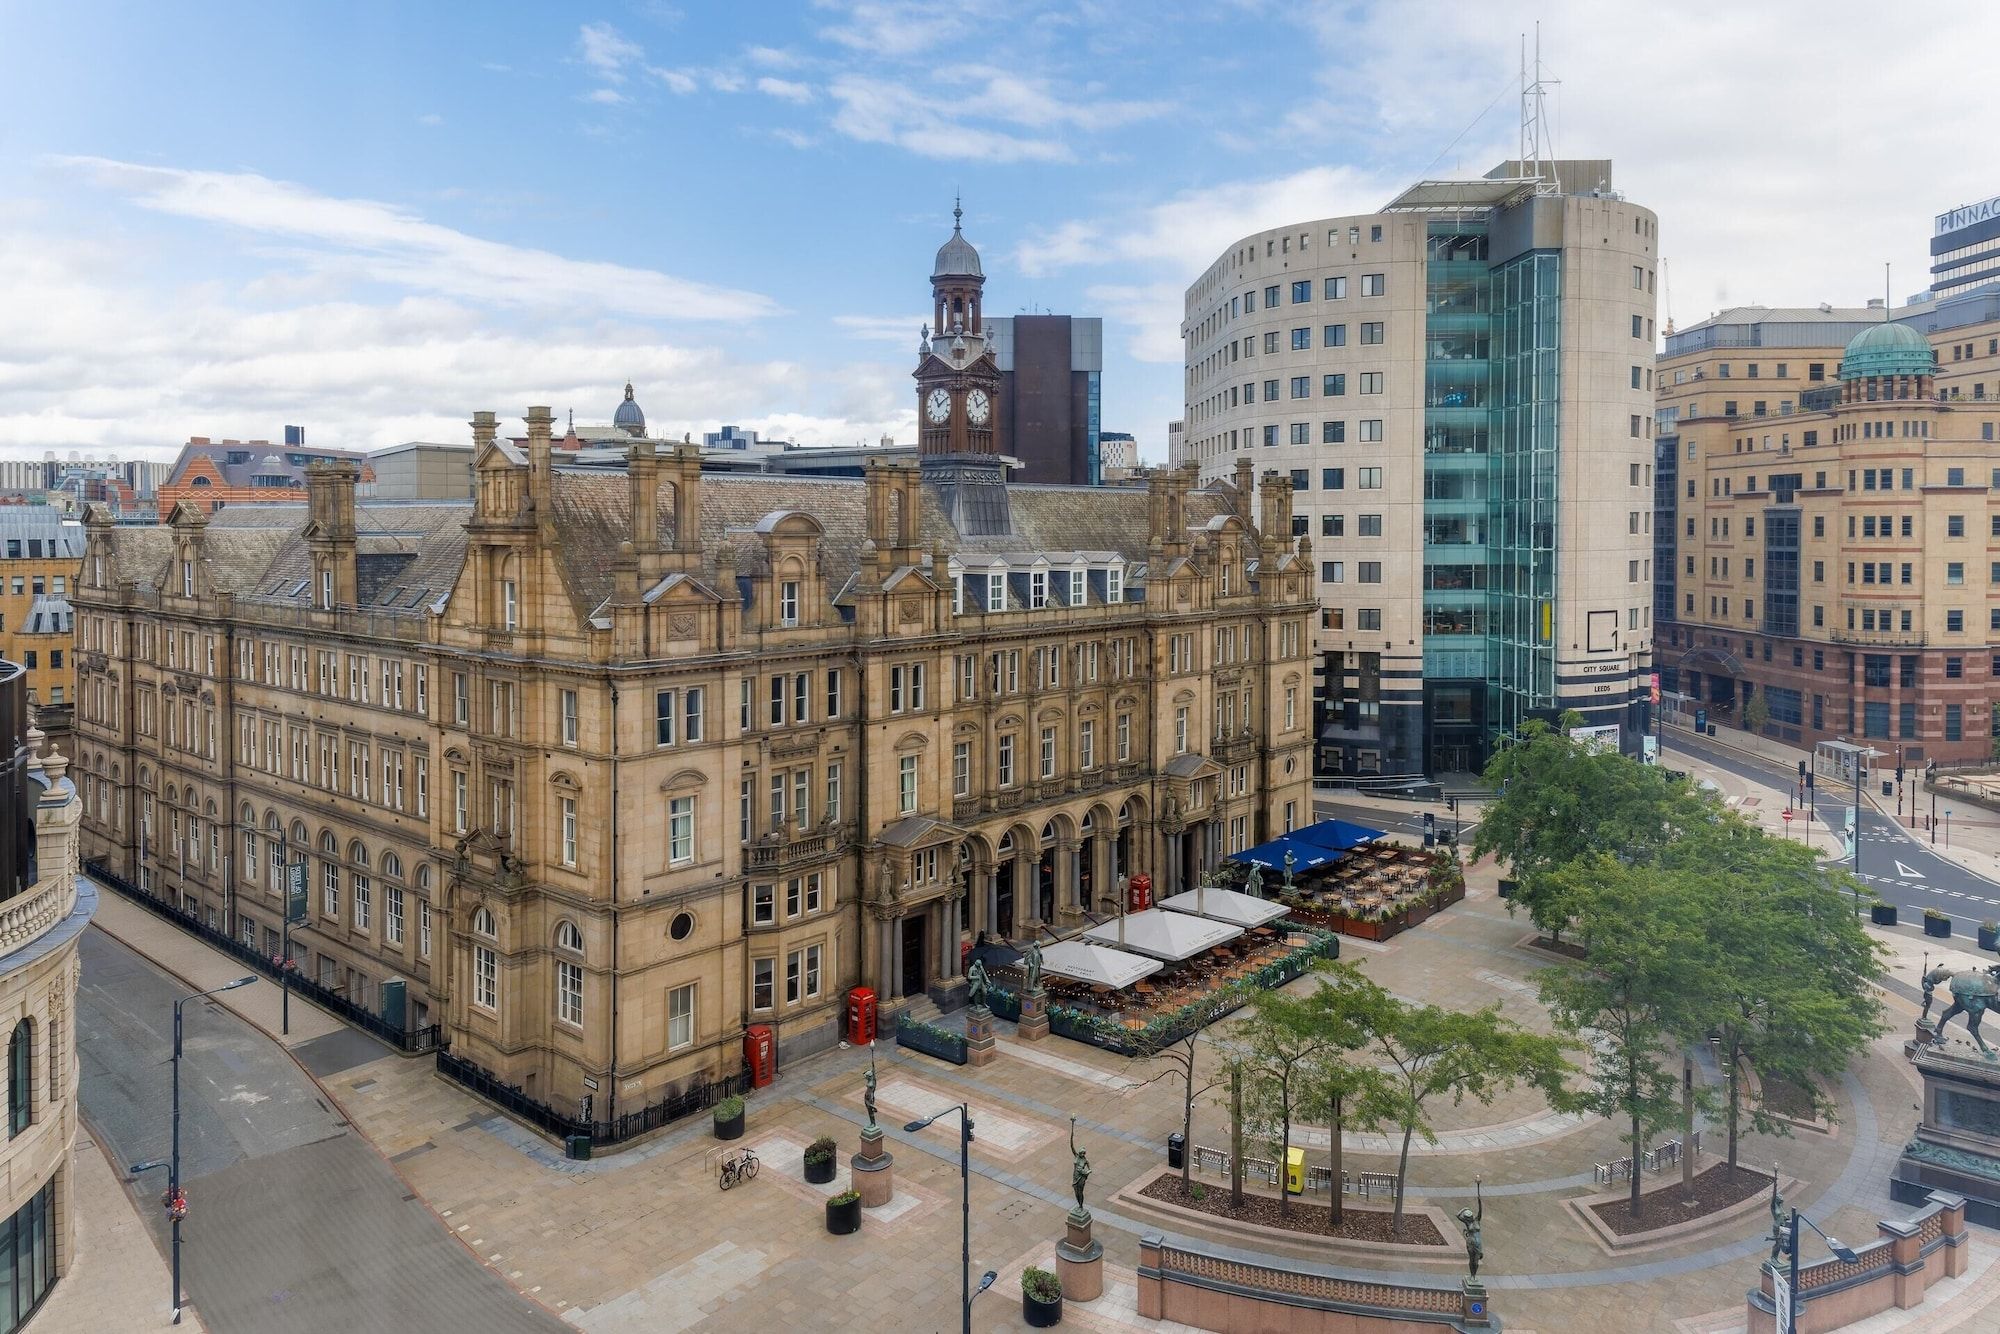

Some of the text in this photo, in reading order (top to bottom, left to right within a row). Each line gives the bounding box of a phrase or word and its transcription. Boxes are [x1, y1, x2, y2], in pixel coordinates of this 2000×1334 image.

[1599, 664, 1620, 672] SQUARE
[1594, 685, 1611, 693] LEEDS
[295, 884, 302, 894] OF
